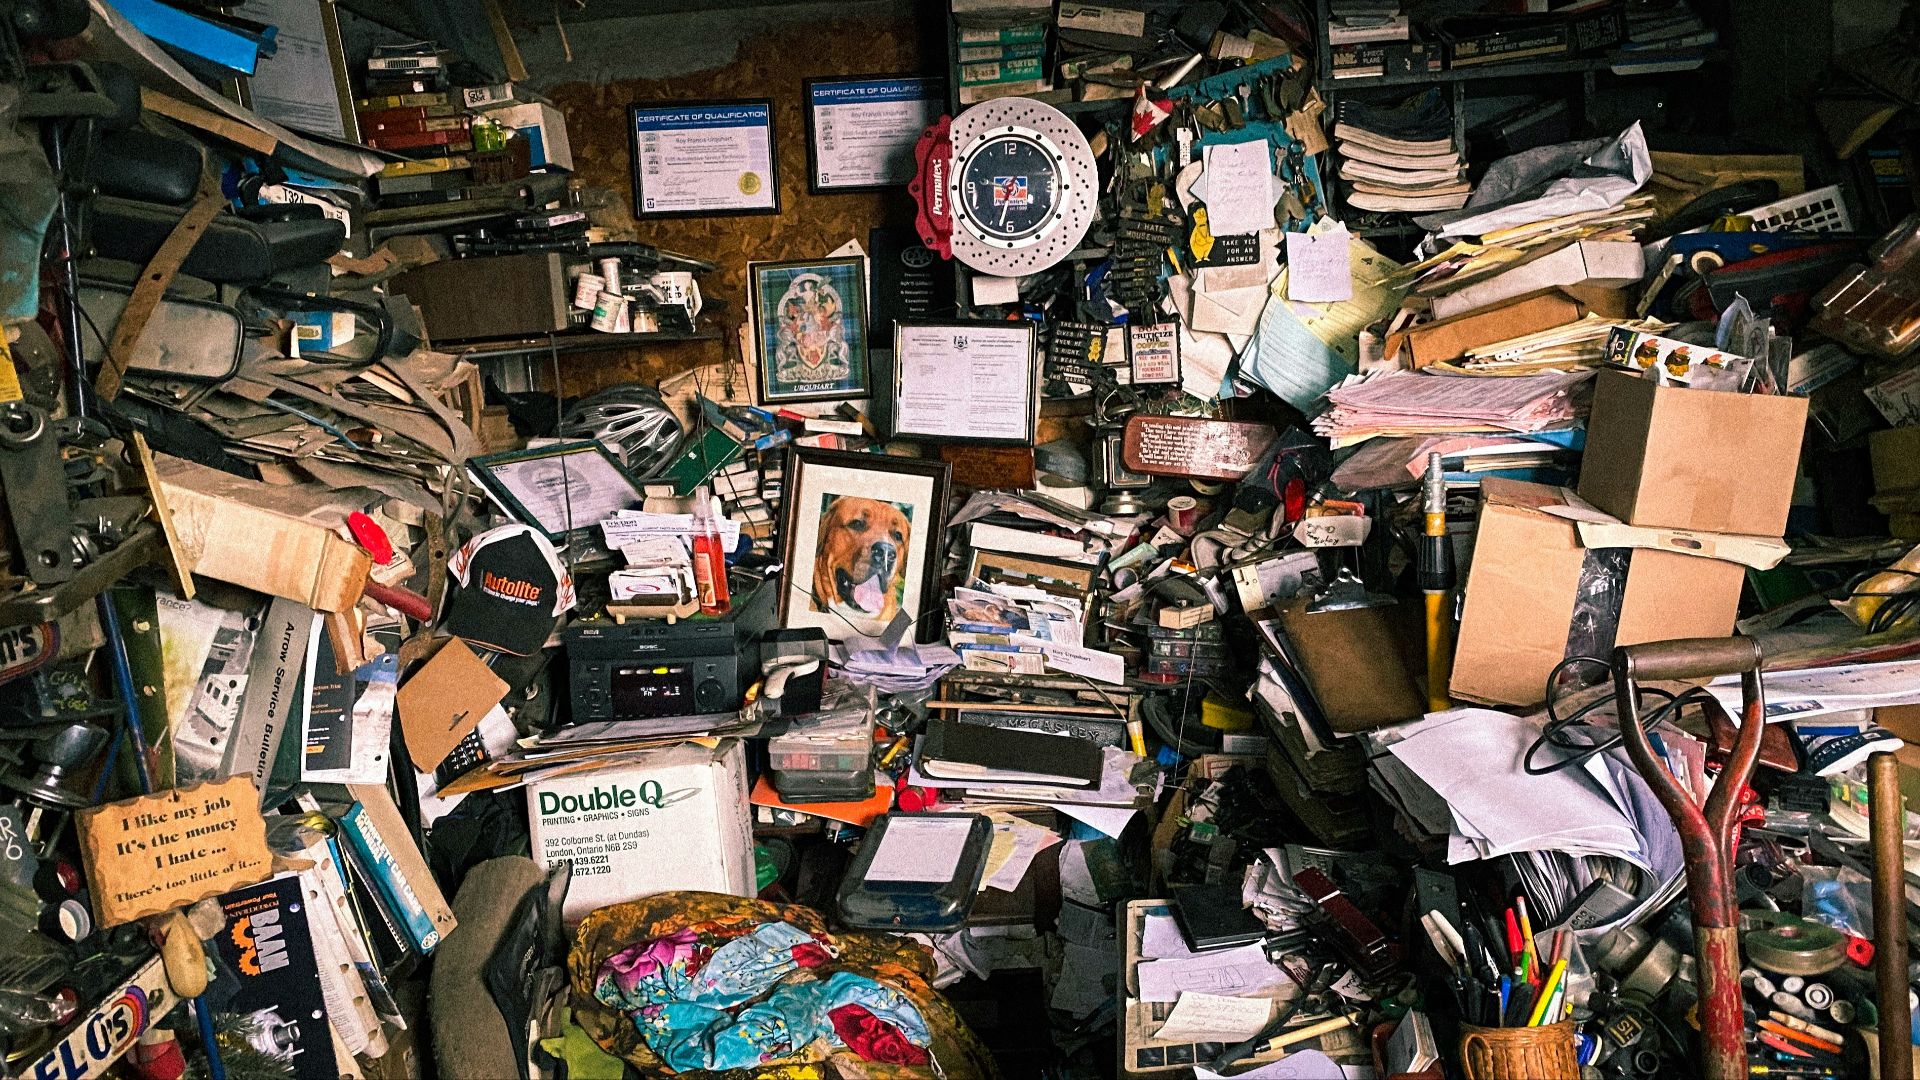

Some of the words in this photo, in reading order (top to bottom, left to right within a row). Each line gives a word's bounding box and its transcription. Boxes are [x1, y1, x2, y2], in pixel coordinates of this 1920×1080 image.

[813, 88, 865, 97] CERTIFICATE
[638, 114, 690, 123] CERTIFICATE
[704, 110, 767, 120] QUALIFICATION
[1004, 143, 1017, 154] 12
[933, 161, 942, 216] Permatex
[967, 182, 975, 193] 9
[1006, 220, 1014, 232] 6
[1144, 224, 1164, 232] HATE
[1222, 239, 1238, 247] TAKE
[1132, 331, 1173, 340] CRITICIZE
[1139, 324, 1168, 332] DON'T
[793, 382, 835, 392] URQUHART
[484, 569, 540, 601] Autolite
[279, 621, 296, 662] Arrow
[266, 665, 287, 721] Service
[255, 723, 275, 780] Bulletin
[538, 784, 637, 816] Double
[639, 779, 665, 809] Q
[122, 818, 130, 831] I
[135, 811, 168, 829] like
[174, 804, 199, 819] my
[203, 796, 231, 816] job
[542, 815, 576, 827] PRINTING
[583, 811, 619, 824] GRAPHICS
[627, 807, 650, 818] SIGNS
[116, 838, 147, 856] It's
[151, 831, 180, 848] the
[186, 816, 238, 839] money
[354, 815, 382, 863] MANUAL
[545, 837, 560, 848] 392
[561, 835, 594, 846] Colborne
[595, 834, 606, 843] St.
[606, 833, 618, 843] (at
[618, 830, 650, 841] Dundas)
[155, 855, 163, 869] I
[169, 847, 207, 866] hate
[546, 847, 577, 858] London,
[577, 845, 604, 855] Ontario
[605, 843, 621, 853] N6B
[622, 840, 638, 851] 2S9
[361, 810, 392, 864] COMPLETE
[389, 861, 408, 890] CAR
[404, 886, 423, 916] CARE
[557, 856, 609, 867] 51.439.6221
[114, 883, 162, 904] There's
[166, 878, 187, 890] too
[190, 869, 219, 883] little
[222, 863, 236, 874] of
[238, 859, 262, 870] it...
[224, 895, 262, 910] Powertrain
[261, 892, 278, 901] Your
